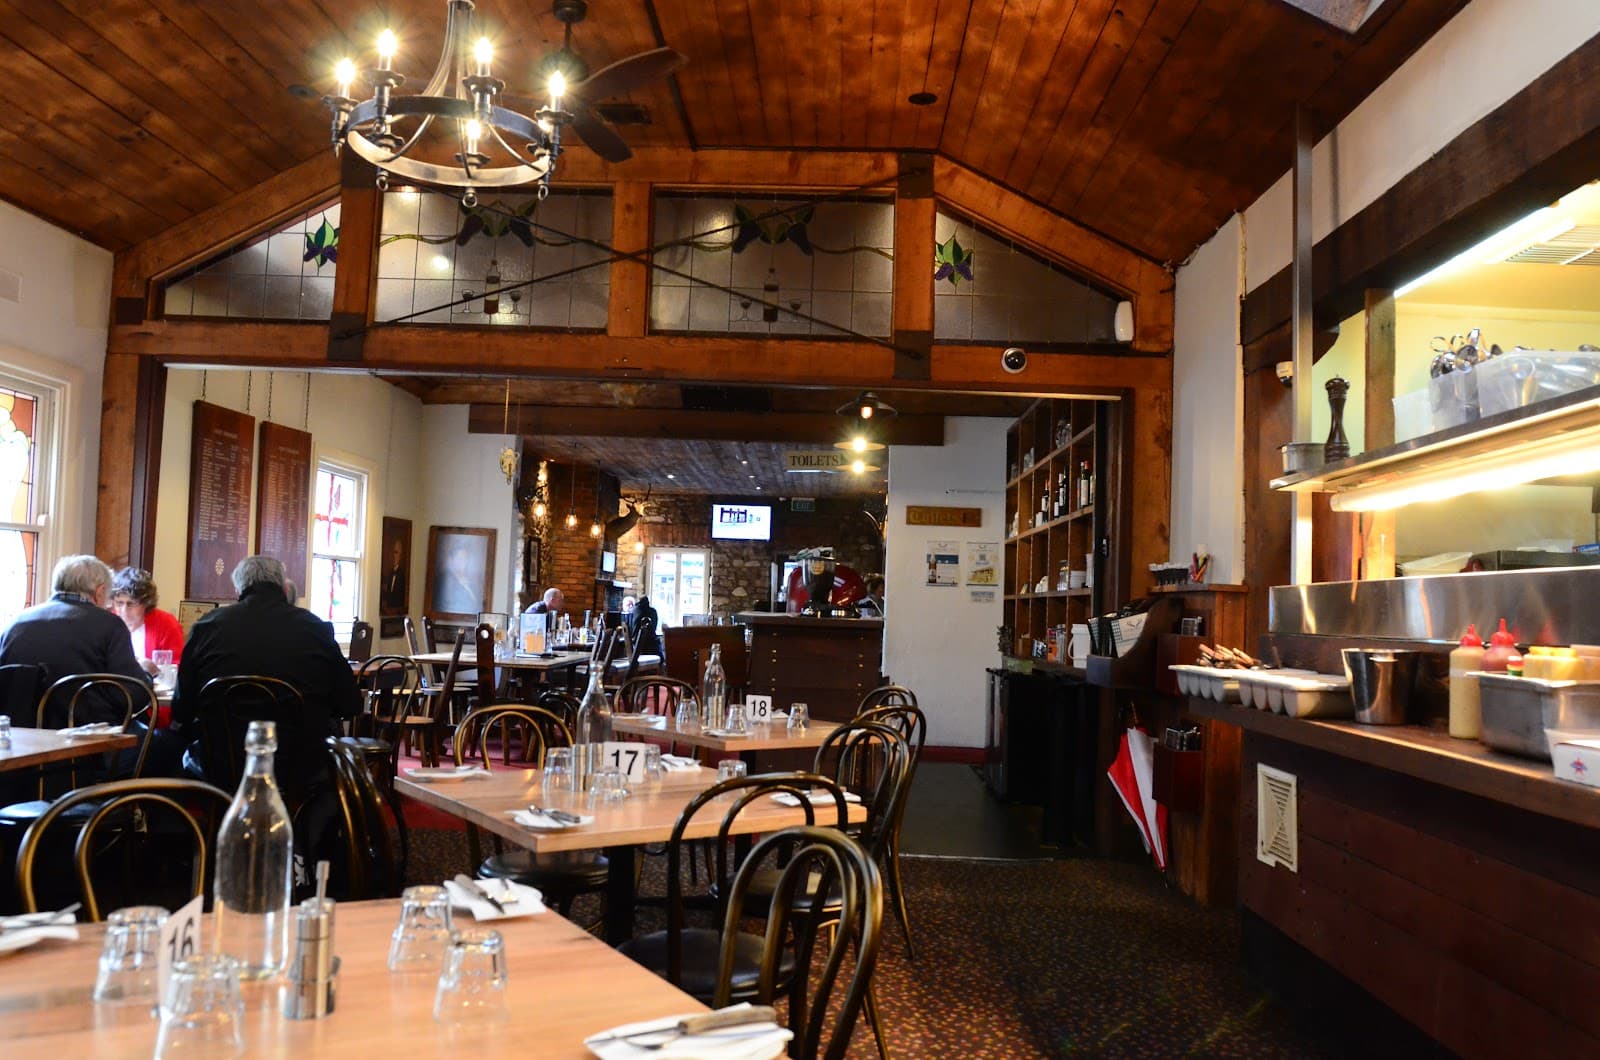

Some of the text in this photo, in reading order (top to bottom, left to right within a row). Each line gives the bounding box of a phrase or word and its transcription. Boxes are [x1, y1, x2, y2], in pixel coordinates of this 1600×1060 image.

[790, 455, 839, 466] TOILETS
[751, 700, 767, 717] 18
[611, 749, 638, 775] 17
